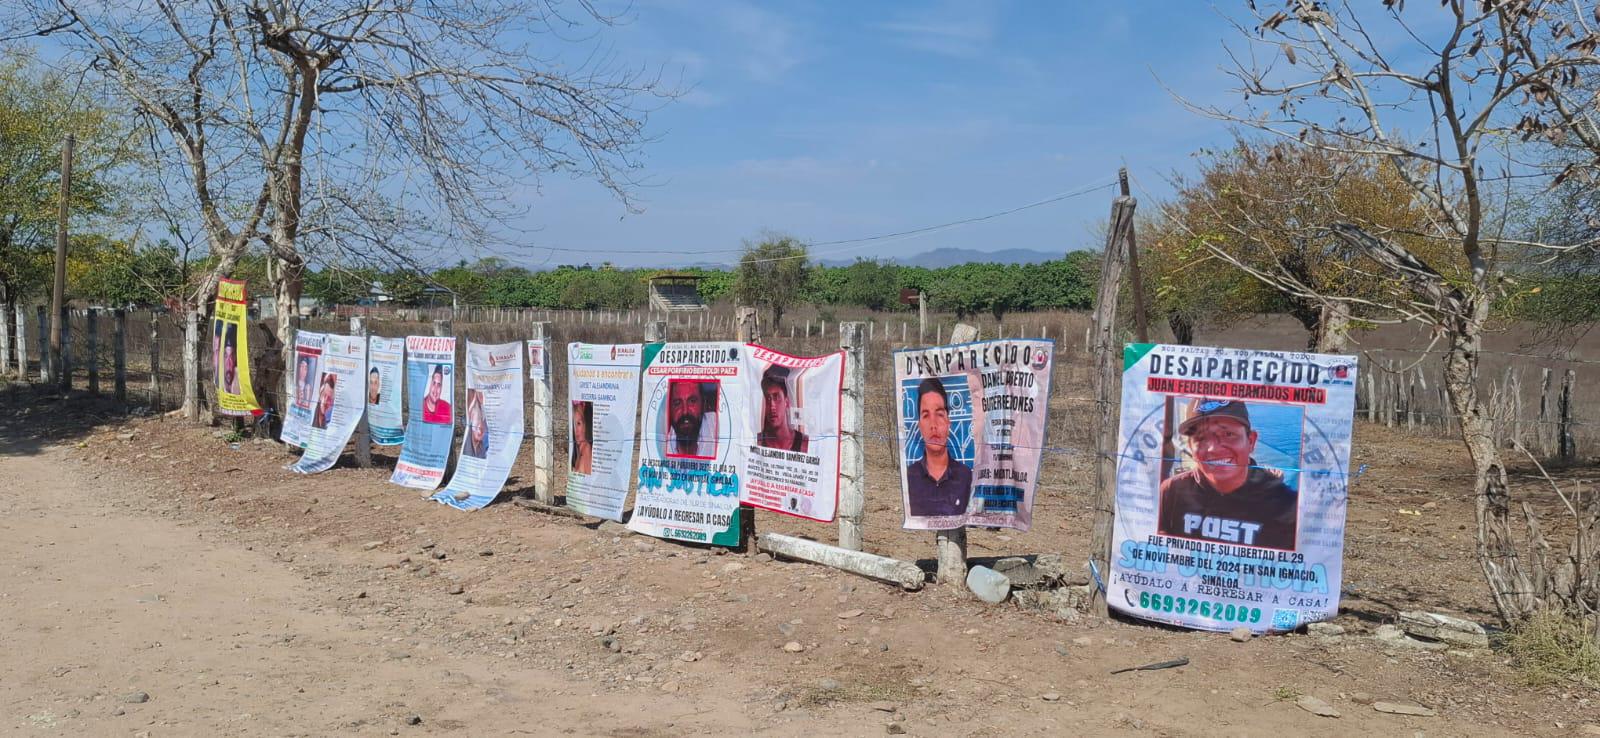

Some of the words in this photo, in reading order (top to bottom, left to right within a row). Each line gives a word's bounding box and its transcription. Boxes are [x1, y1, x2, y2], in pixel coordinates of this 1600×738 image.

[660, 350, 726, 364] DESAPARECIDO
[906, 345, 1031, 376] DESAPARECIDO
[1149, 354, 1320, 386] DESAPARECIDO
[1290, 353, 1316, 361] TODOS
[1148, 378, 1175, 392] JUAN
[1178, 380, 1227, 396] FEDERICO
[1231, 384, 1289, 401] GRANADOS
[1293, 386, 1324, 404] NUÑO
[674, 509, 704, 524] REGRESAR
[706, 513, 711, 524] A
[1183, 512, 1261, 545] POST
[1148, 535, 1163, 547] FUE
[1166, 538, 1202, 553] PRIVADO
[1204, 544, 1215, 554] DE
[1218, 545, 1231, 556] SU
[1232, 547, 1275, 562] LIBERTAD
[1278, 552, 1289, 562] EL
[1291, 553, 1304, 564] 29
[1132, 548, 1143, 560] DE
[1145, 551, 1195, 567] NOVIEMBRE
[1198, 558, 1213, 570] DEL
[1216, 561, 1240, 573] 2024
[1243, 563, 1254, 575] EN
[1257, 565, 1276, 578] SAN
[1279, 567, 1318, 583] IGNACIO,
[1139, 591, 1262, 624] 6693262089
[1181, 583, 1188, 592] A
[1197, 584, 1263, 602] REGRESAR
[1272, 595, 1279, 604] A
[1288, 597, 1329, 608] CASA!
